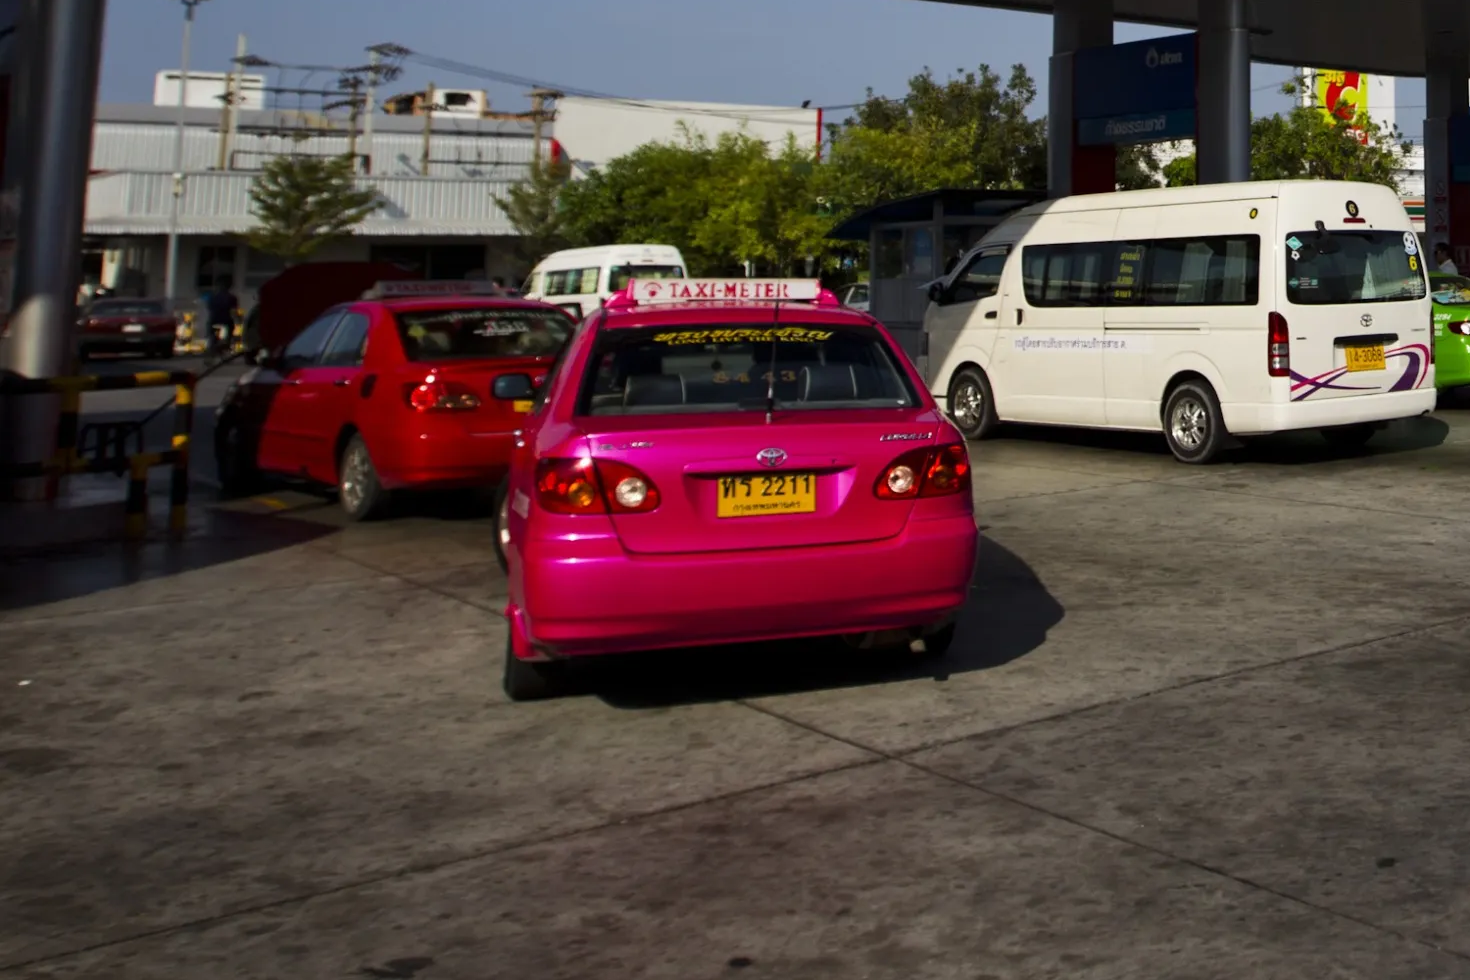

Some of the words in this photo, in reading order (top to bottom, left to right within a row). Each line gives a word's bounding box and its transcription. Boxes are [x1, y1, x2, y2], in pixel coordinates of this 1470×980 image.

[1409, 256, 1418, 270] 6
[670, 282, 789, 298] TAXI-METER
[761, 474, 811, 497] 2211
